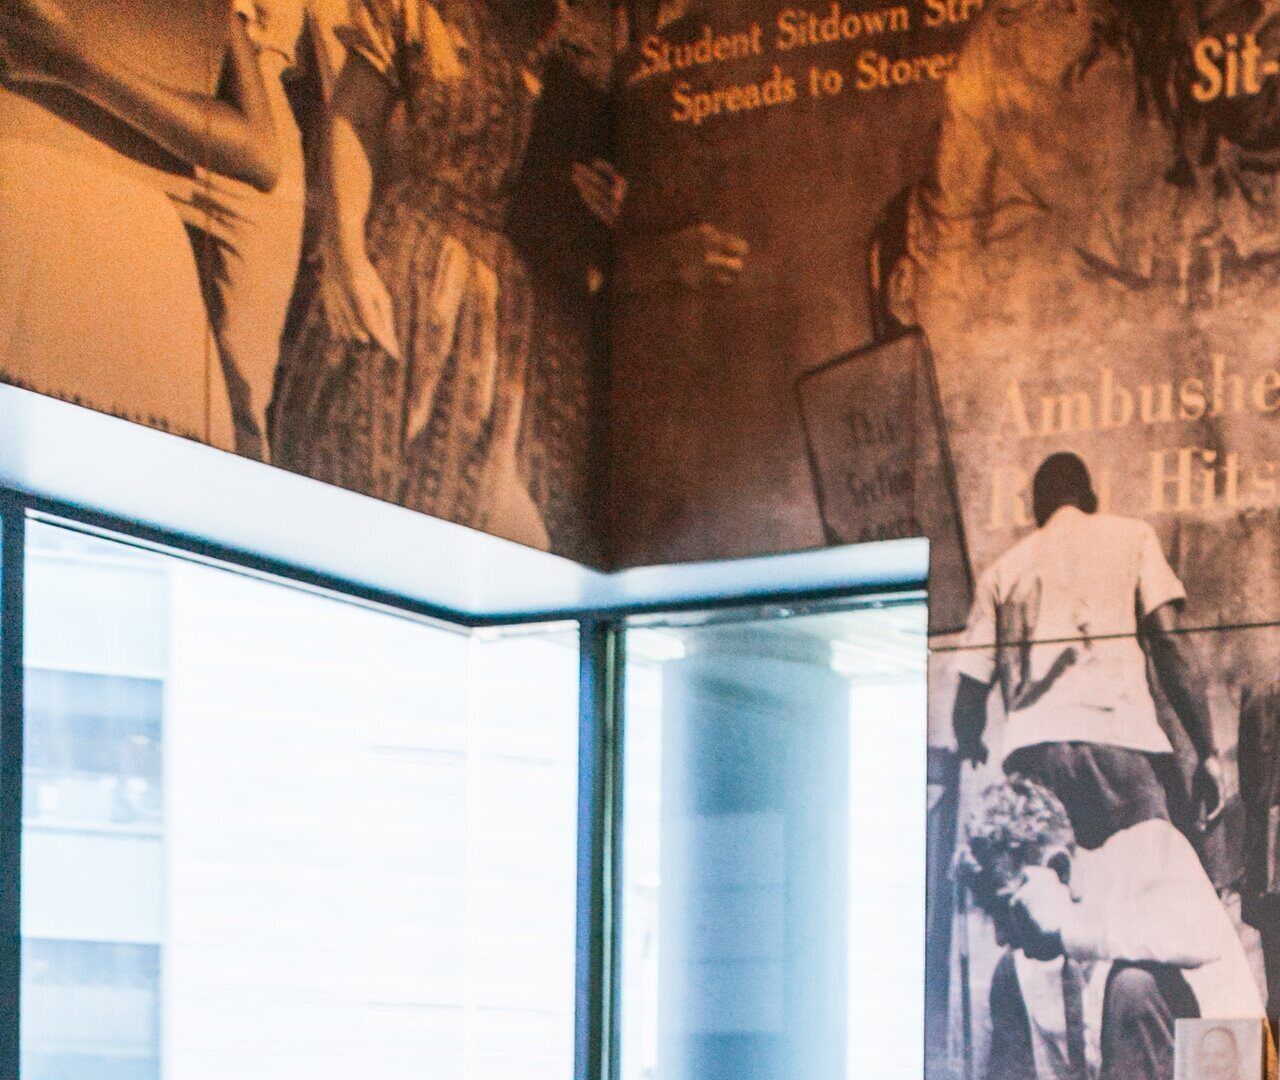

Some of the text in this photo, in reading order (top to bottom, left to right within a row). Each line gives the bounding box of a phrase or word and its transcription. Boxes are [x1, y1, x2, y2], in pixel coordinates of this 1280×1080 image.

[641, 22, 763, 72] Student
[775, 2, 910, 51] Sitdown
[671, 64, 798, 125] Spreads
[809, 65, 844, 97] to
[1150, 446, 1278, 513] Hits
